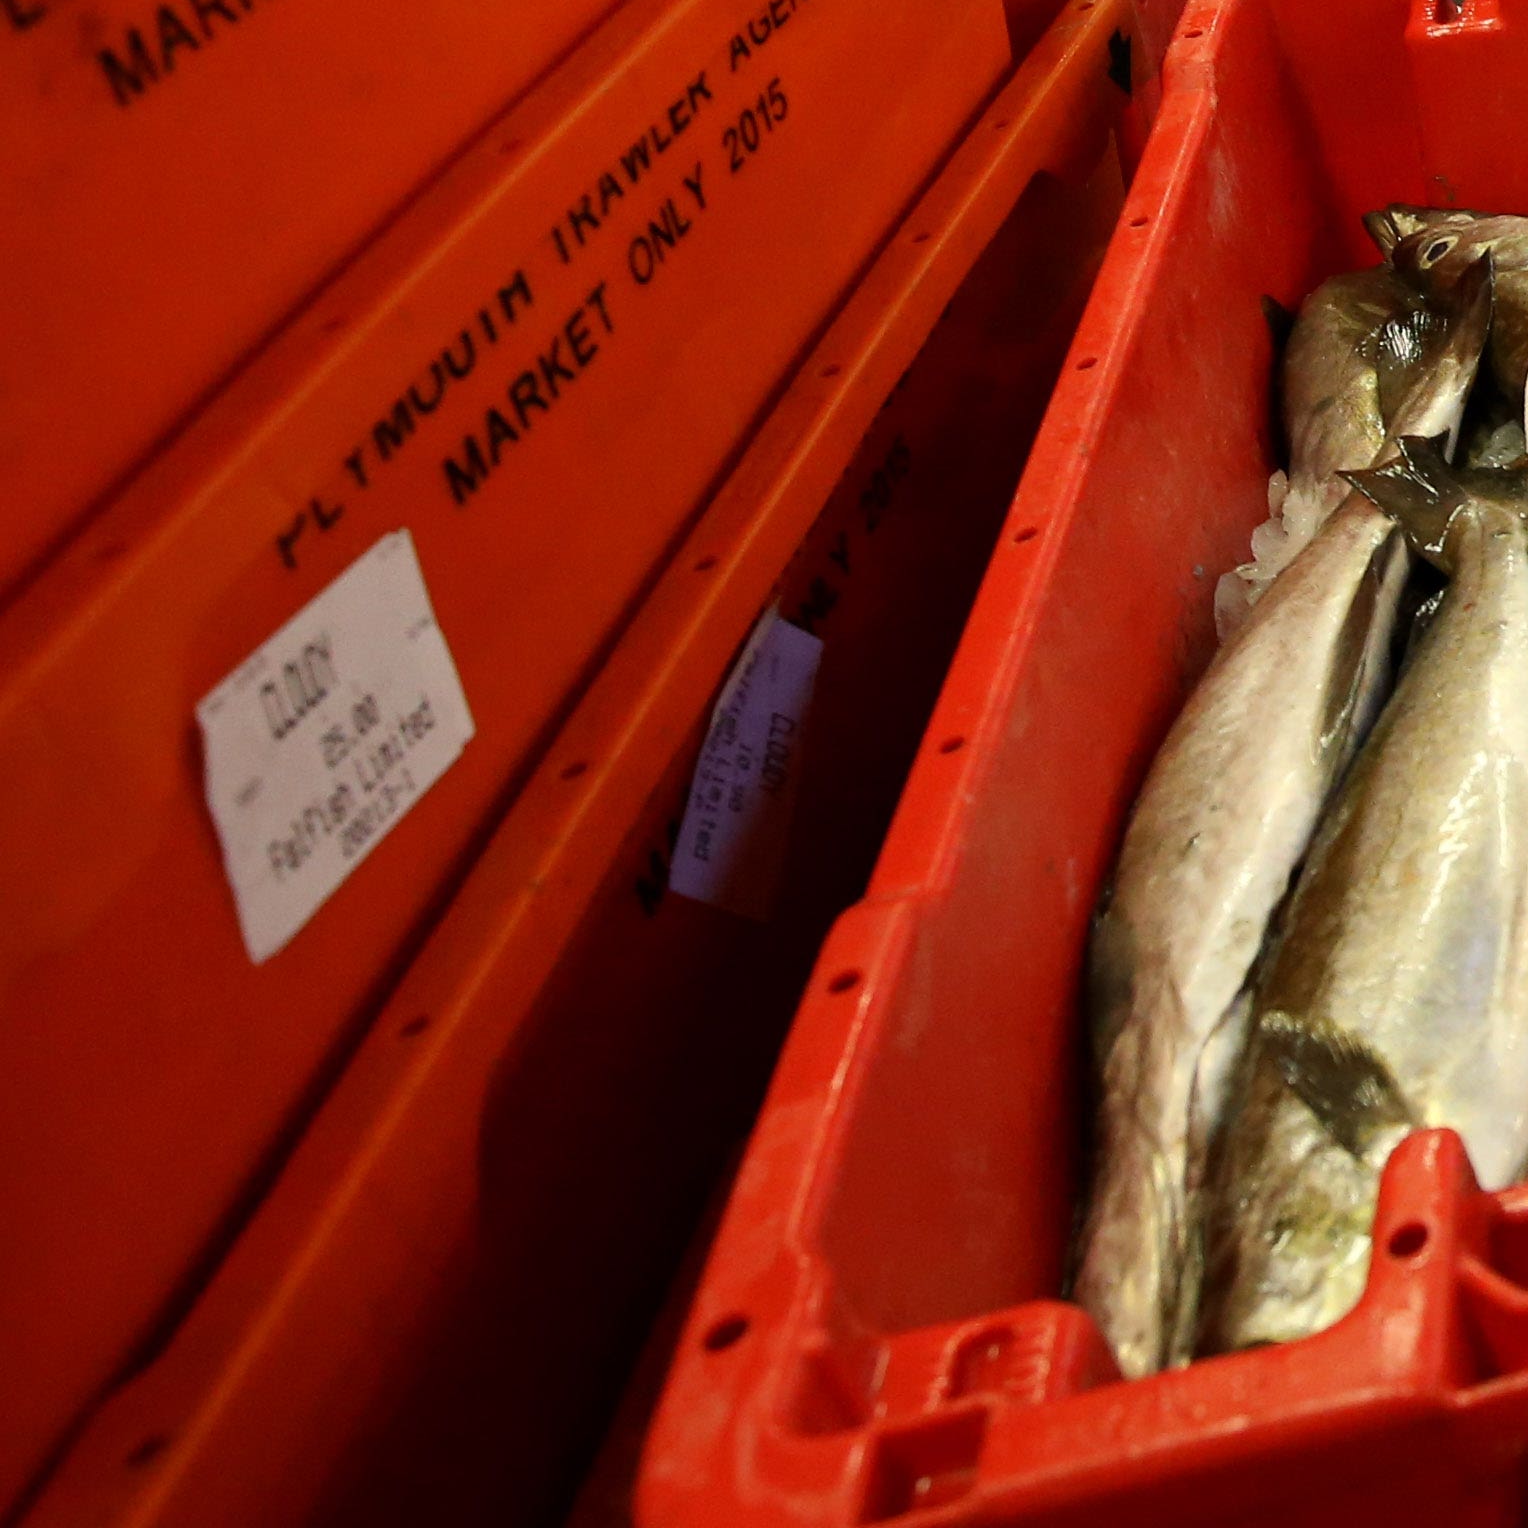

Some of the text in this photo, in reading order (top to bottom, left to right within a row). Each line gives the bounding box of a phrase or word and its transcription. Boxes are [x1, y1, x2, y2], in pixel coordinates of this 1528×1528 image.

[441, 76, 792, 506] MARKET ONLY 2015
